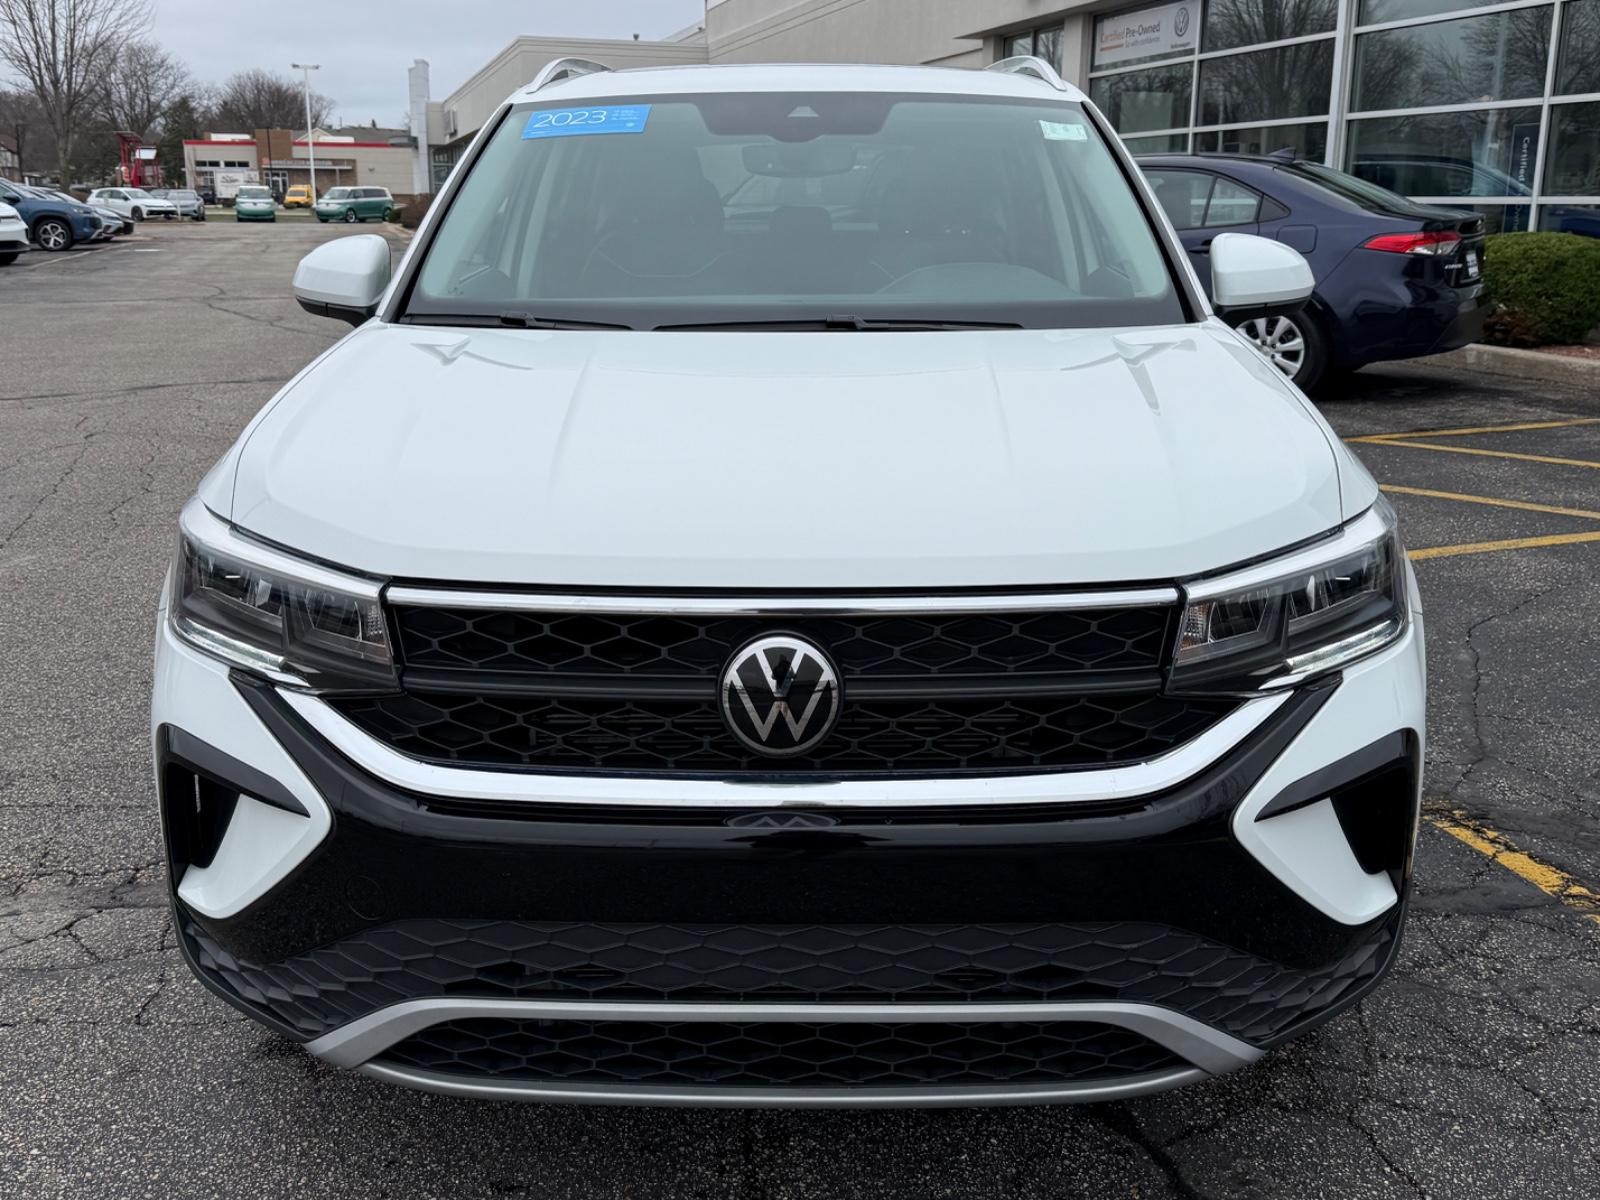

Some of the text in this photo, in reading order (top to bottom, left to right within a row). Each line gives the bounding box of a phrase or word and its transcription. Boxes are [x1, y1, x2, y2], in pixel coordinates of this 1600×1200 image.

[1126, 20, 1161, 38] Pre-Owned
[533, 110, 607, 128] 2023
[1519, 137, 1530, 181] Certified
